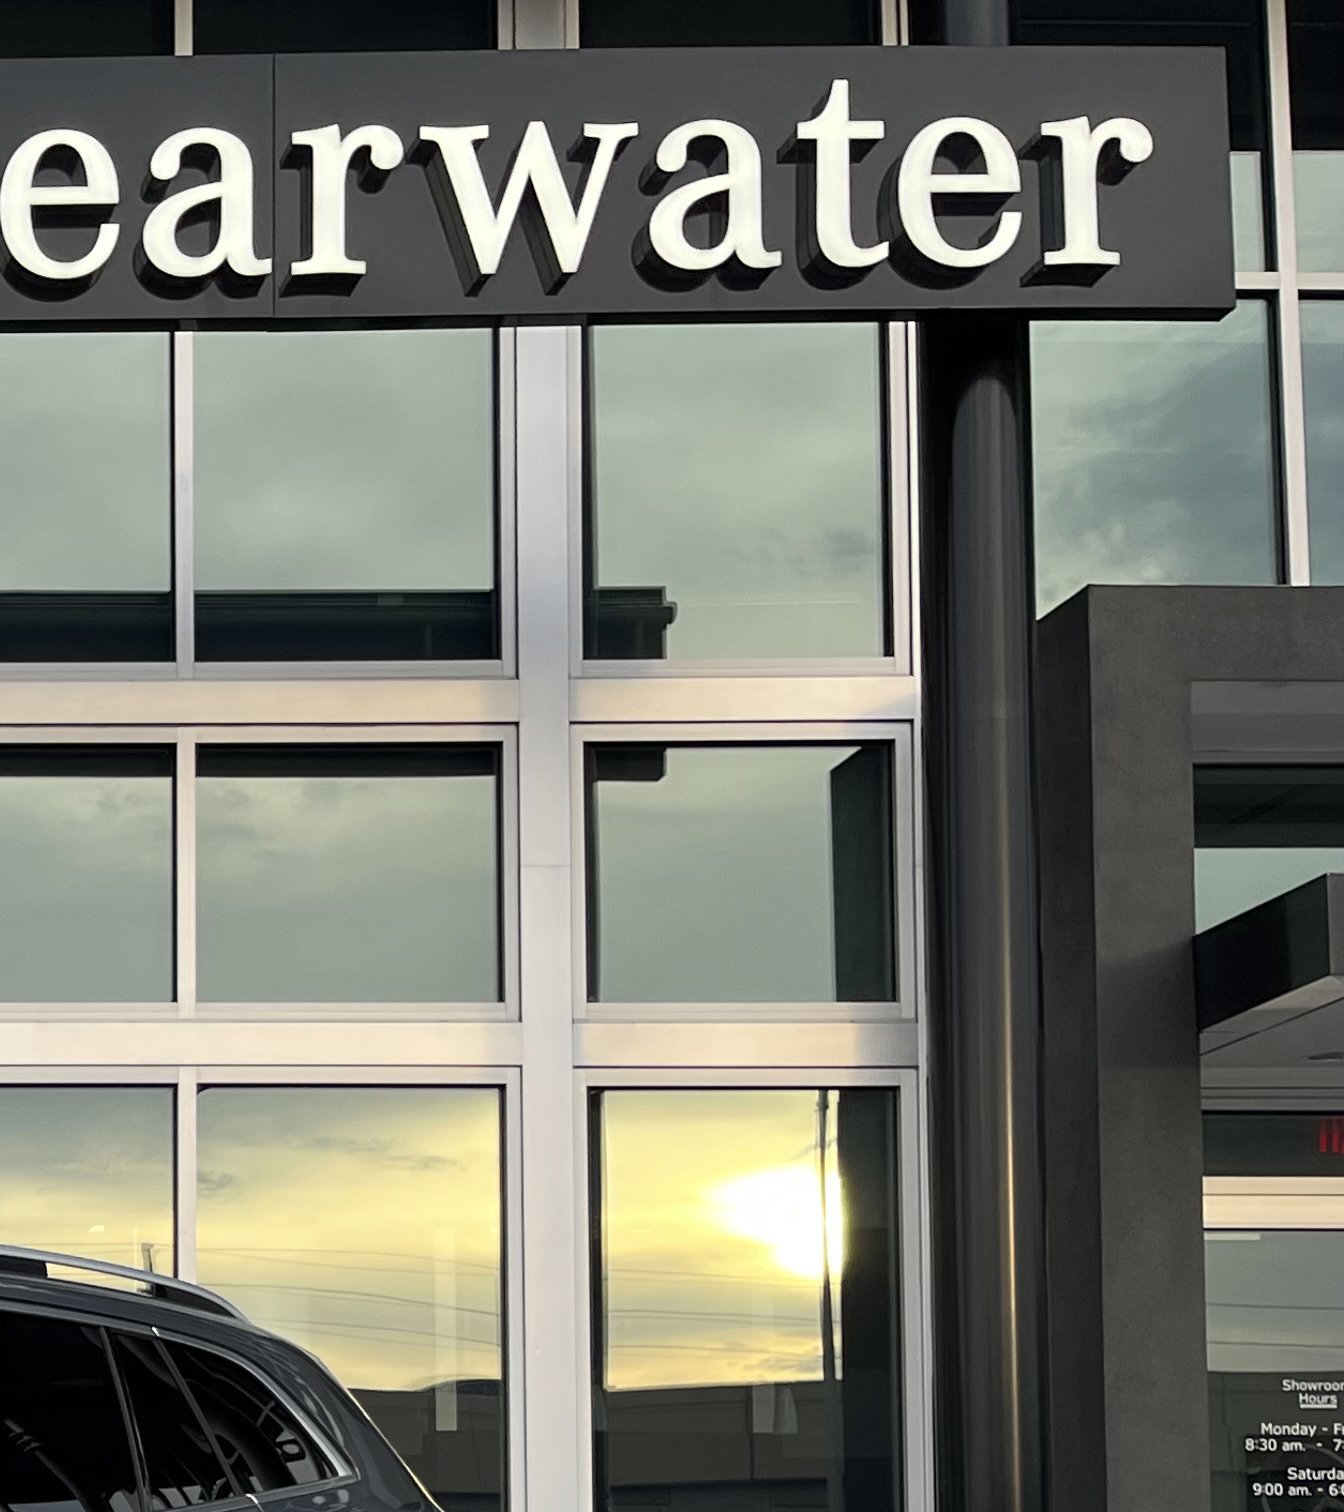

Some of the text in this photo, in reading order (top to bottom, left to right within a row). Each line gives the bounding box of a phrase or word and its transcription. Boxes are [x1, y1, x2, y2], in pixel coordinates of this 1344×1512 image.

[1298, 1393, 1338, 1405] Hours
[1260, 1422, 1317, 1438] Monday
[1244, 1438, 1277, 1452] 8:30
[1287, 1467, 1344, 1481] Saturda
[1252, 1482, 1284, 1496] 9:00
